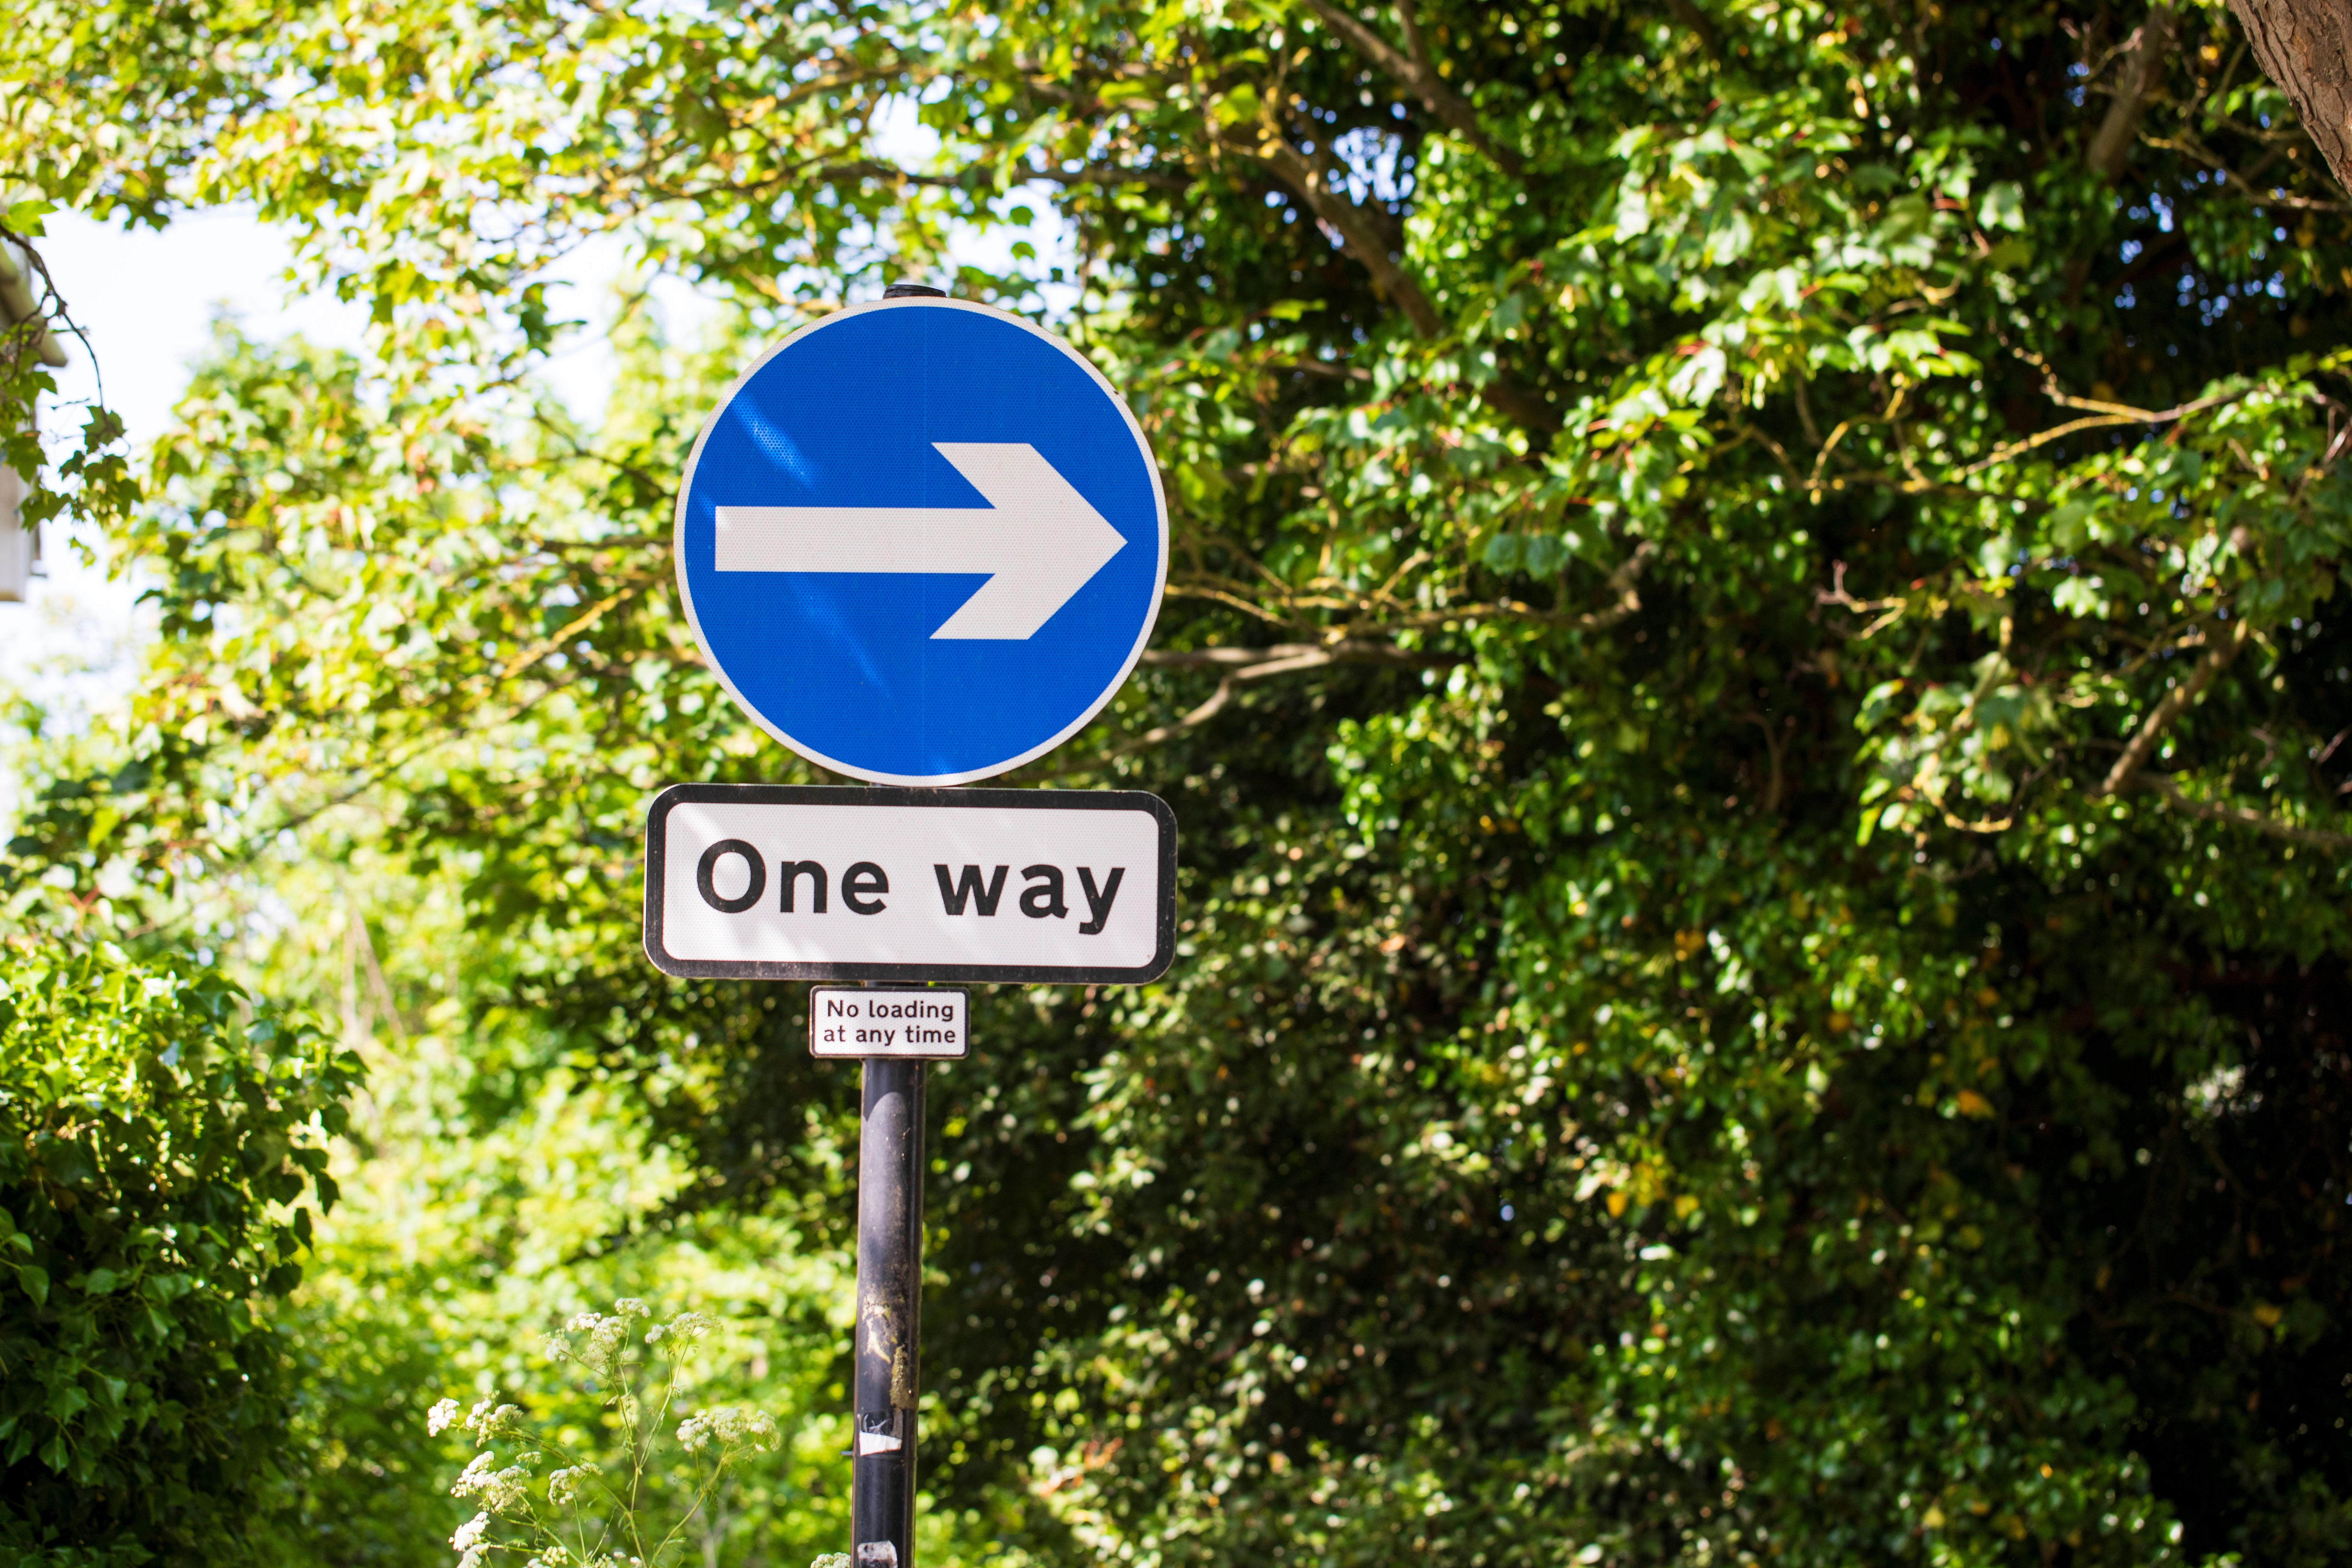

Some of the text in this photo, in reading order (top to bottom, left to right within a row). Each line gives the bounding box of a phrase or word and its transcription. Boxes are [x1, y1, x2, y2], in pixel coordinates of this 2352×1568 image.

[697, 838, 1125, 935] One way
[827, 999, 954, 1022] No loading
[824, 1025, 956, 1046] at any time
